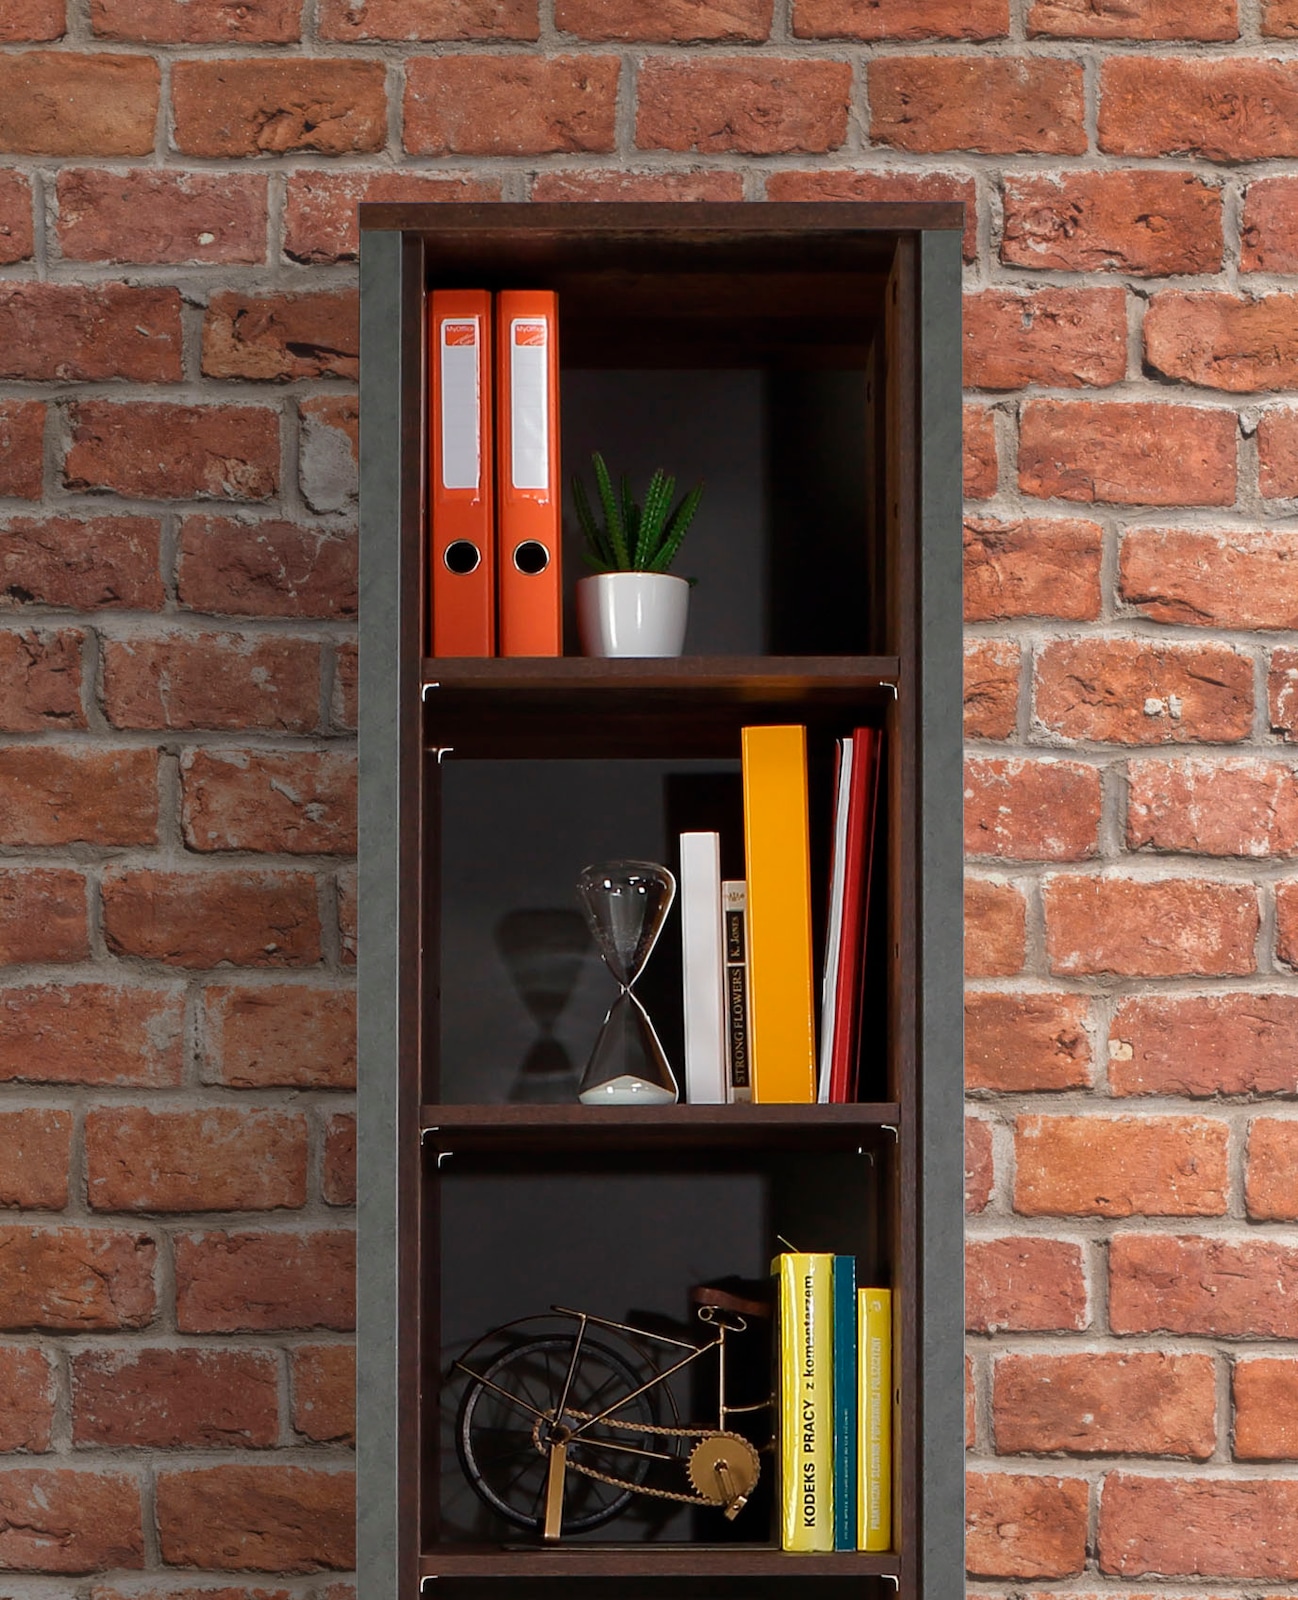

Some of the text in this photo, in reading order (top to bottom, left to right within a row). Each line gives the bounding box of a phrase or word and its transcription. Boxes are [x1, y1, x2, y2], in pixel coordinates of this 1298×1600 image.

[730, 946, 741, 957] K.
[732, 969, 746, 1084] STRONG FLOWERS
[803, 1275, 816, 1527] KODEKS PRACY z komentarzem
